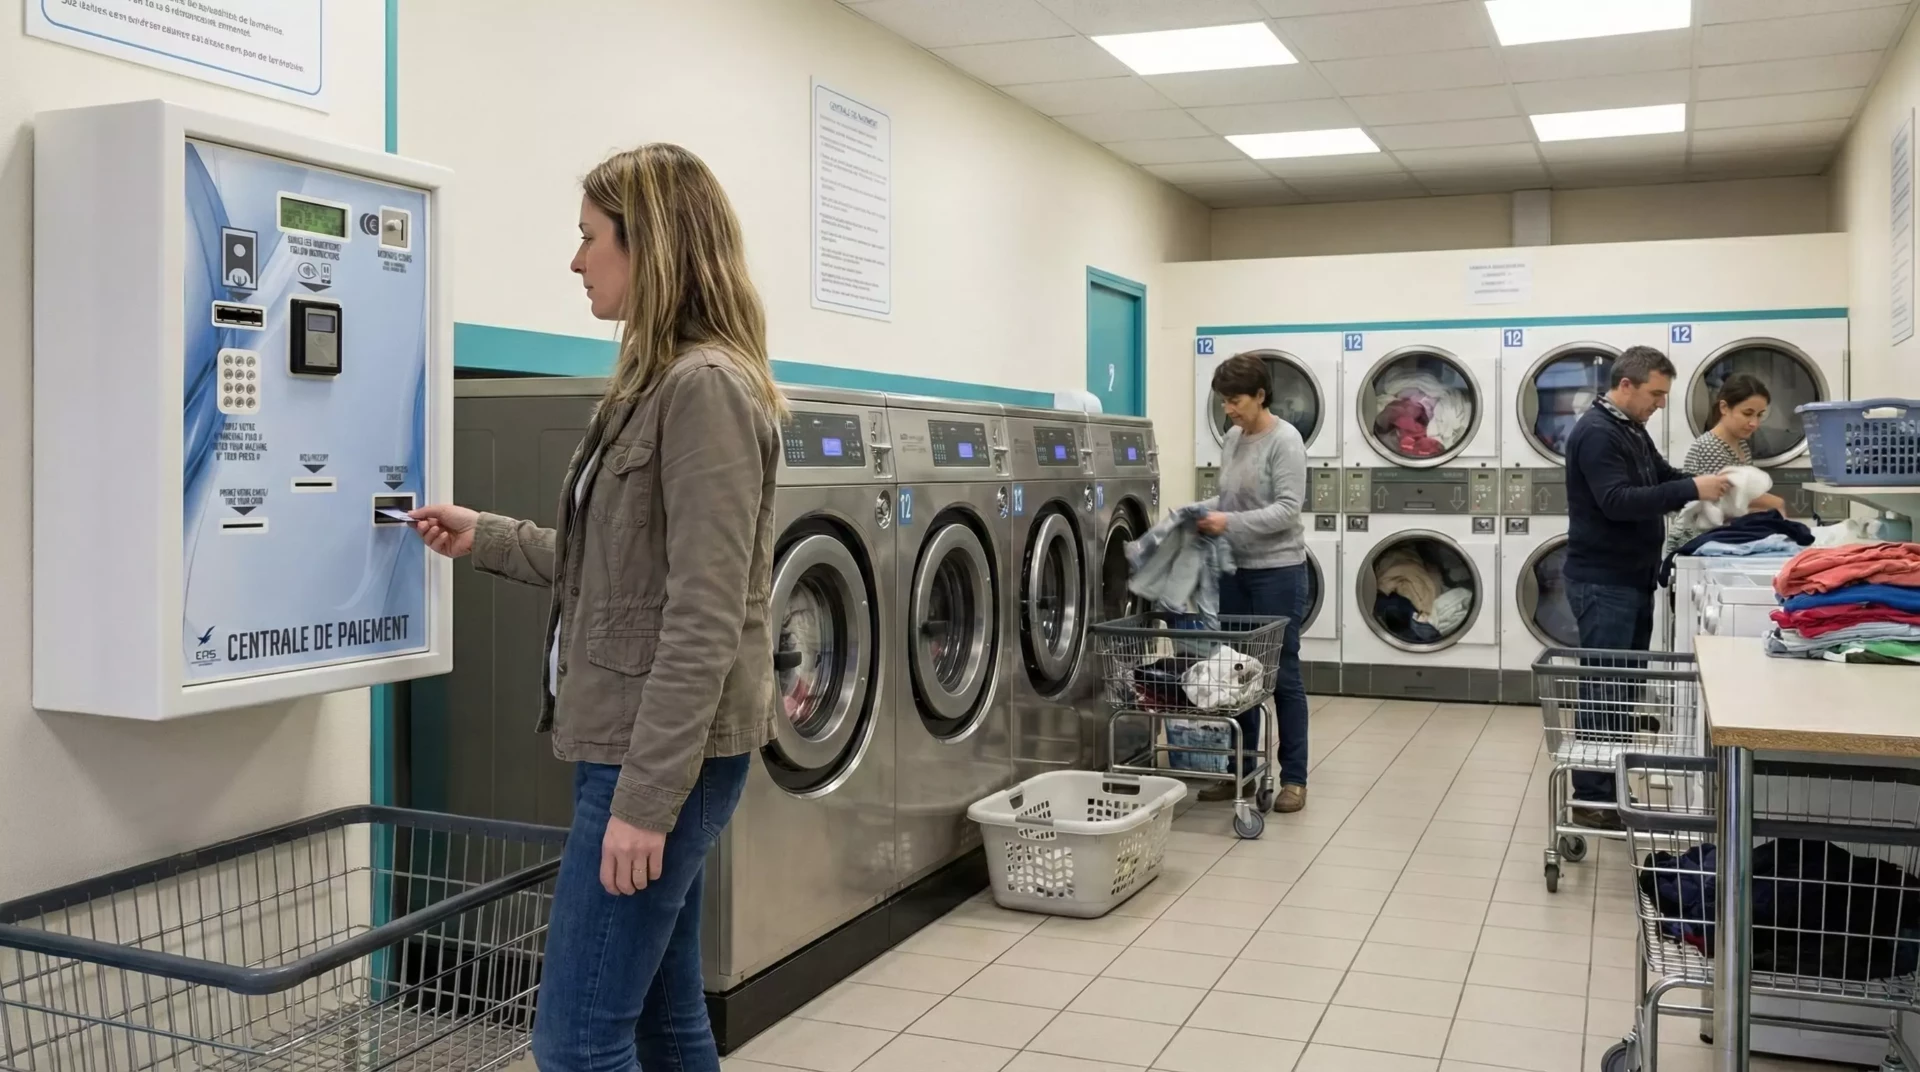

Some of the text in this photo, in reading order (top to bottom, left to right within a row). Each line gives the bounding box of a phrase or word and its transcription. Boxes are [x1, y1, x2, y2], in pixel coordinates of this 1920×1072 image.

[1505, 331, 1522, 346] 12
[1672, 326, 1690, 342] 12
[1197, 339, 1213, 353] 12
[1346, 335, 1362, 349] 12
[900, 493, 912, 519] 12
[227, 614, 409, 662] CENTRALE DE PAIEMENT
